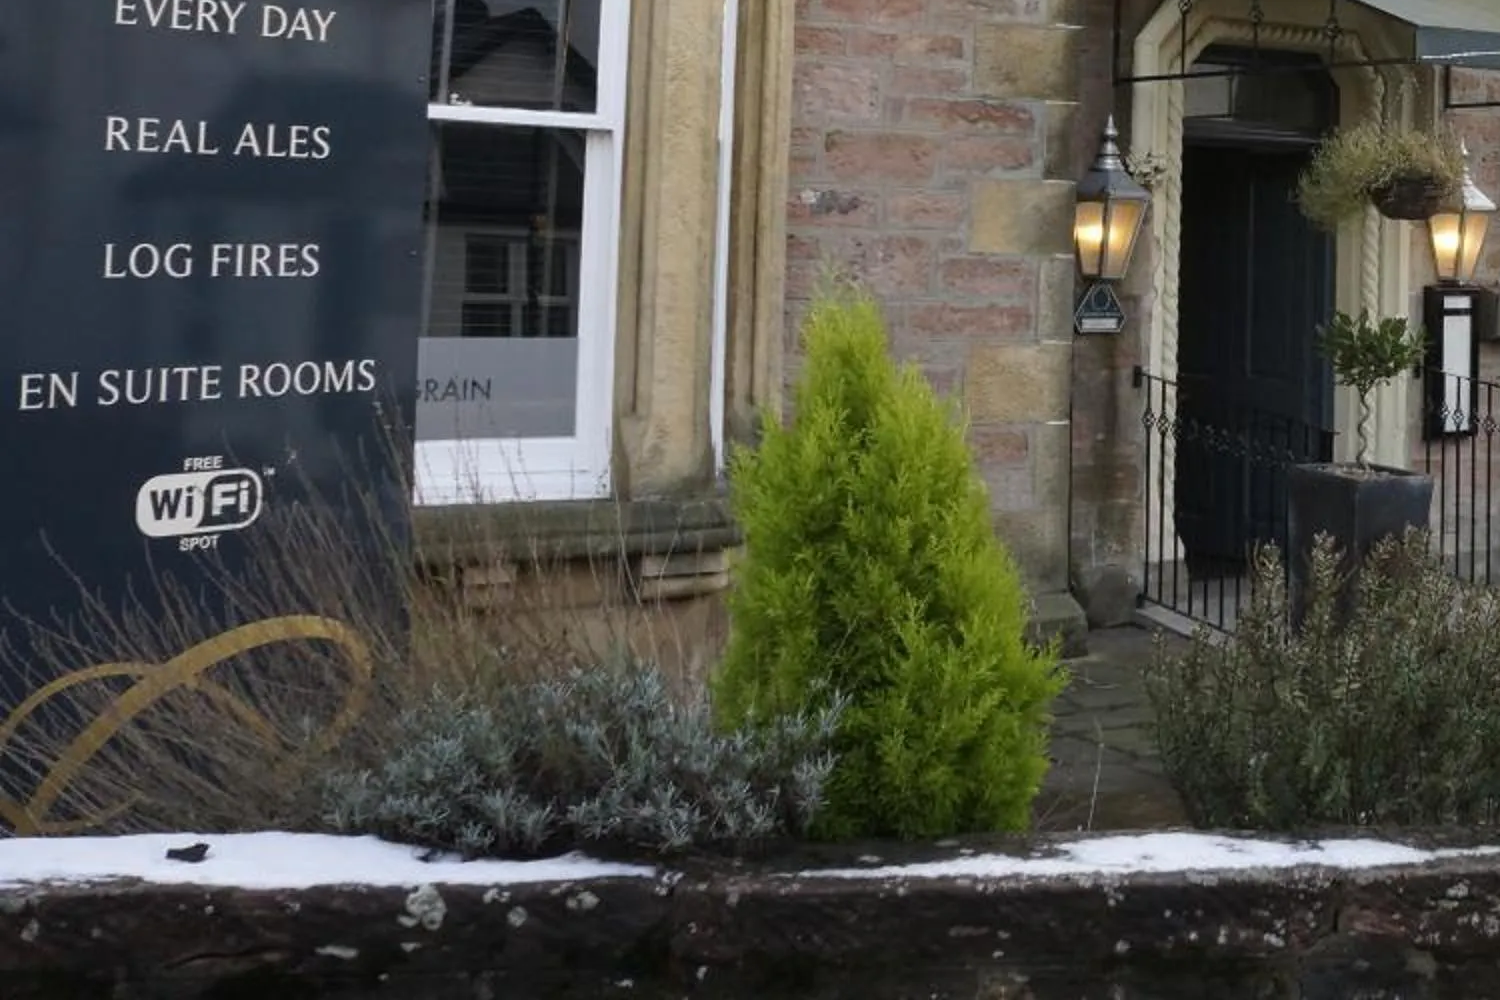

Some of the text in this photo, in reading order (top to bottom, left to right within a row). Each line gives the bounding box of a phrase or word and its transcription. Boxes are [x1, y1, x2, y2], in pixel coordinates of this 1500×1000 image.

[261, 5, 336, 42] DAY
[105, 116, 330, 159] REAL ALES
[104, 243, 320, 279] LOG FIRES
[19, 359, 376, 410] EN SUITE ROOMS
[183, 455, 224, 471] FREE
[179, 534, 220, 551] SPOT
